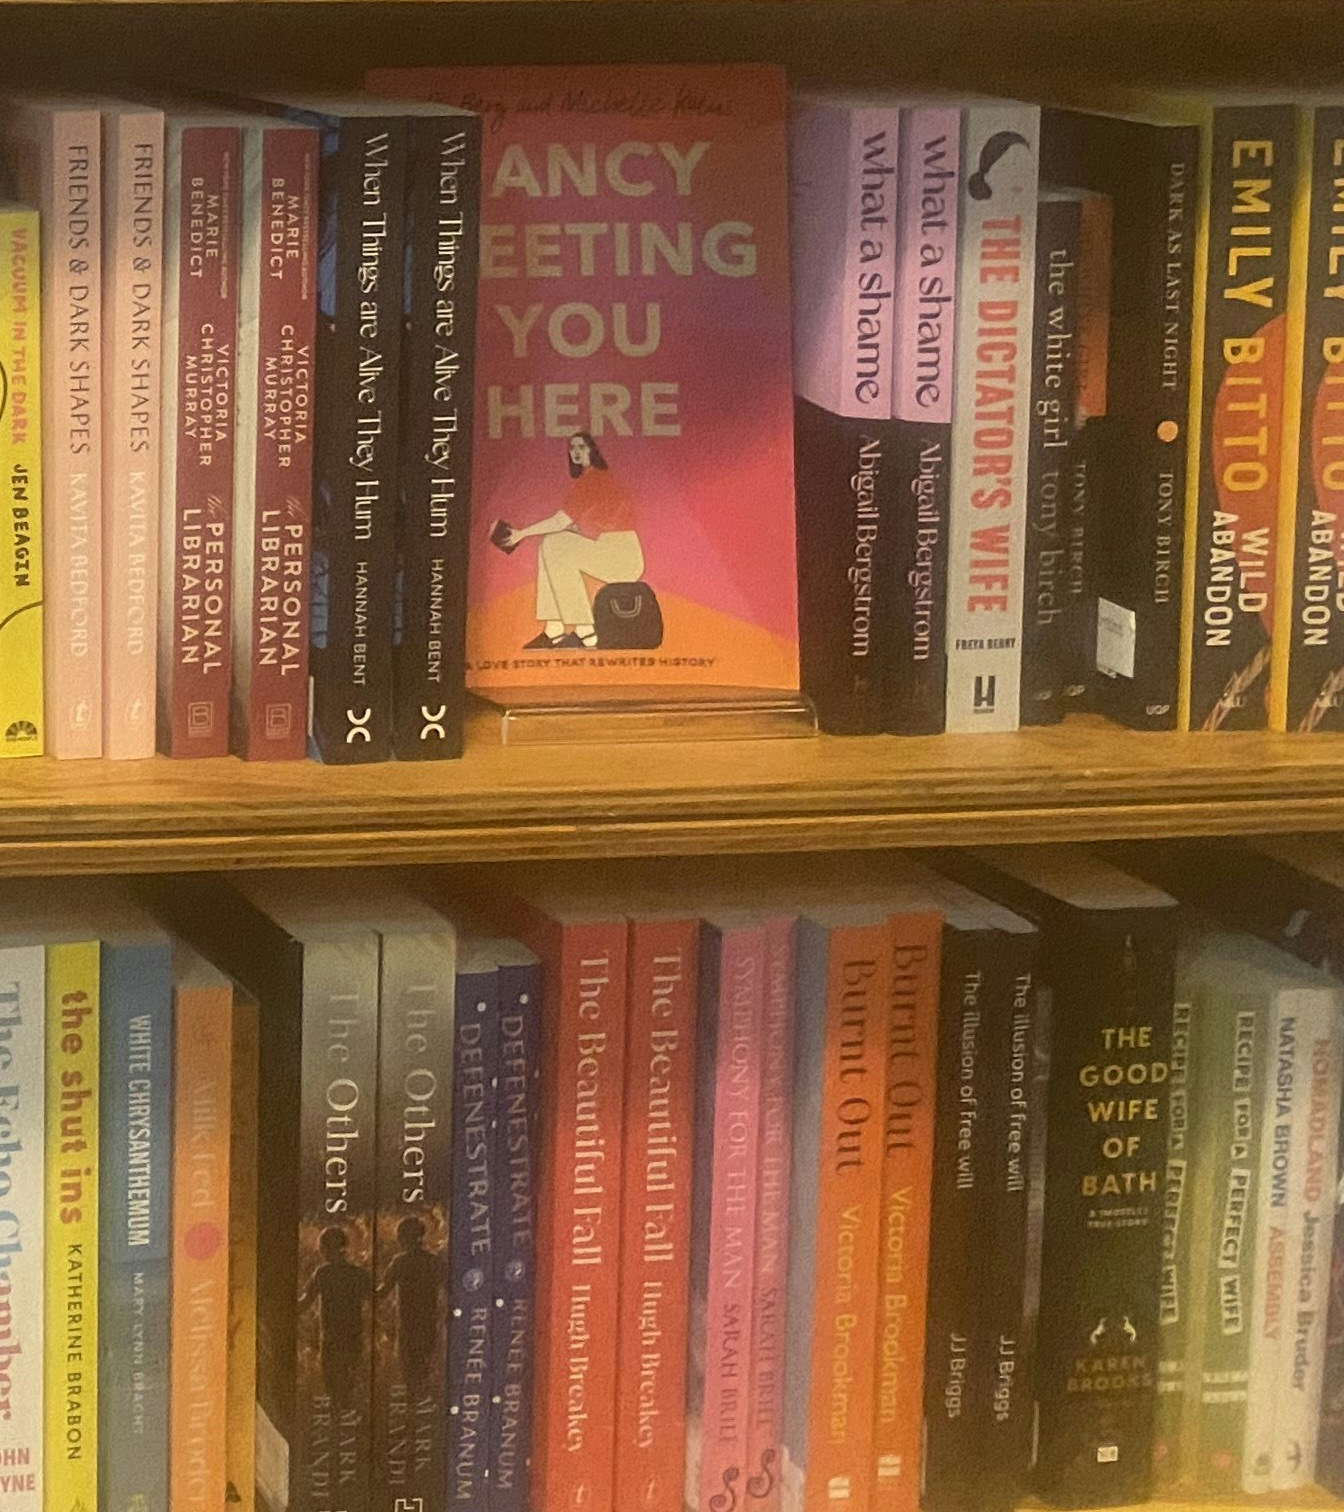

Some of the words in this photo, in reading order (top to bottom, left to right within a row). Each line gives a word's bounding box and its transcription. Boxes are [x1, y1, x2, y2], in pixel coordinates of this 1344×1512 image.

[980, 216, 1022, 285] THE
[496, 302, 662, 359] YOU
[486, 381, 682, 439] HERE
[972, 302, 1019, 511] DICTATOR'S
[430, 558, 446, 634] HANNAH
[967, 524, 1012, 614] WIFE
[427, 638, 442, 684] BENT
[1101, 1025, 1152, 1049] THE
[1078, 1064, 1169, 1088] GOOD
[572, 1033, 607, 1195] Beautiful
[1086, 1099, 1159, 1124] WIFE
[1101, 1136, 1140, 1160] OF
[1080, 1172, 1158, 1198] BATH
[571, 1205, 603, 1265] Fall
[66, 1242, 83, 1361] KATHERINE
[66, 1368, 82, 1462] BRABON
